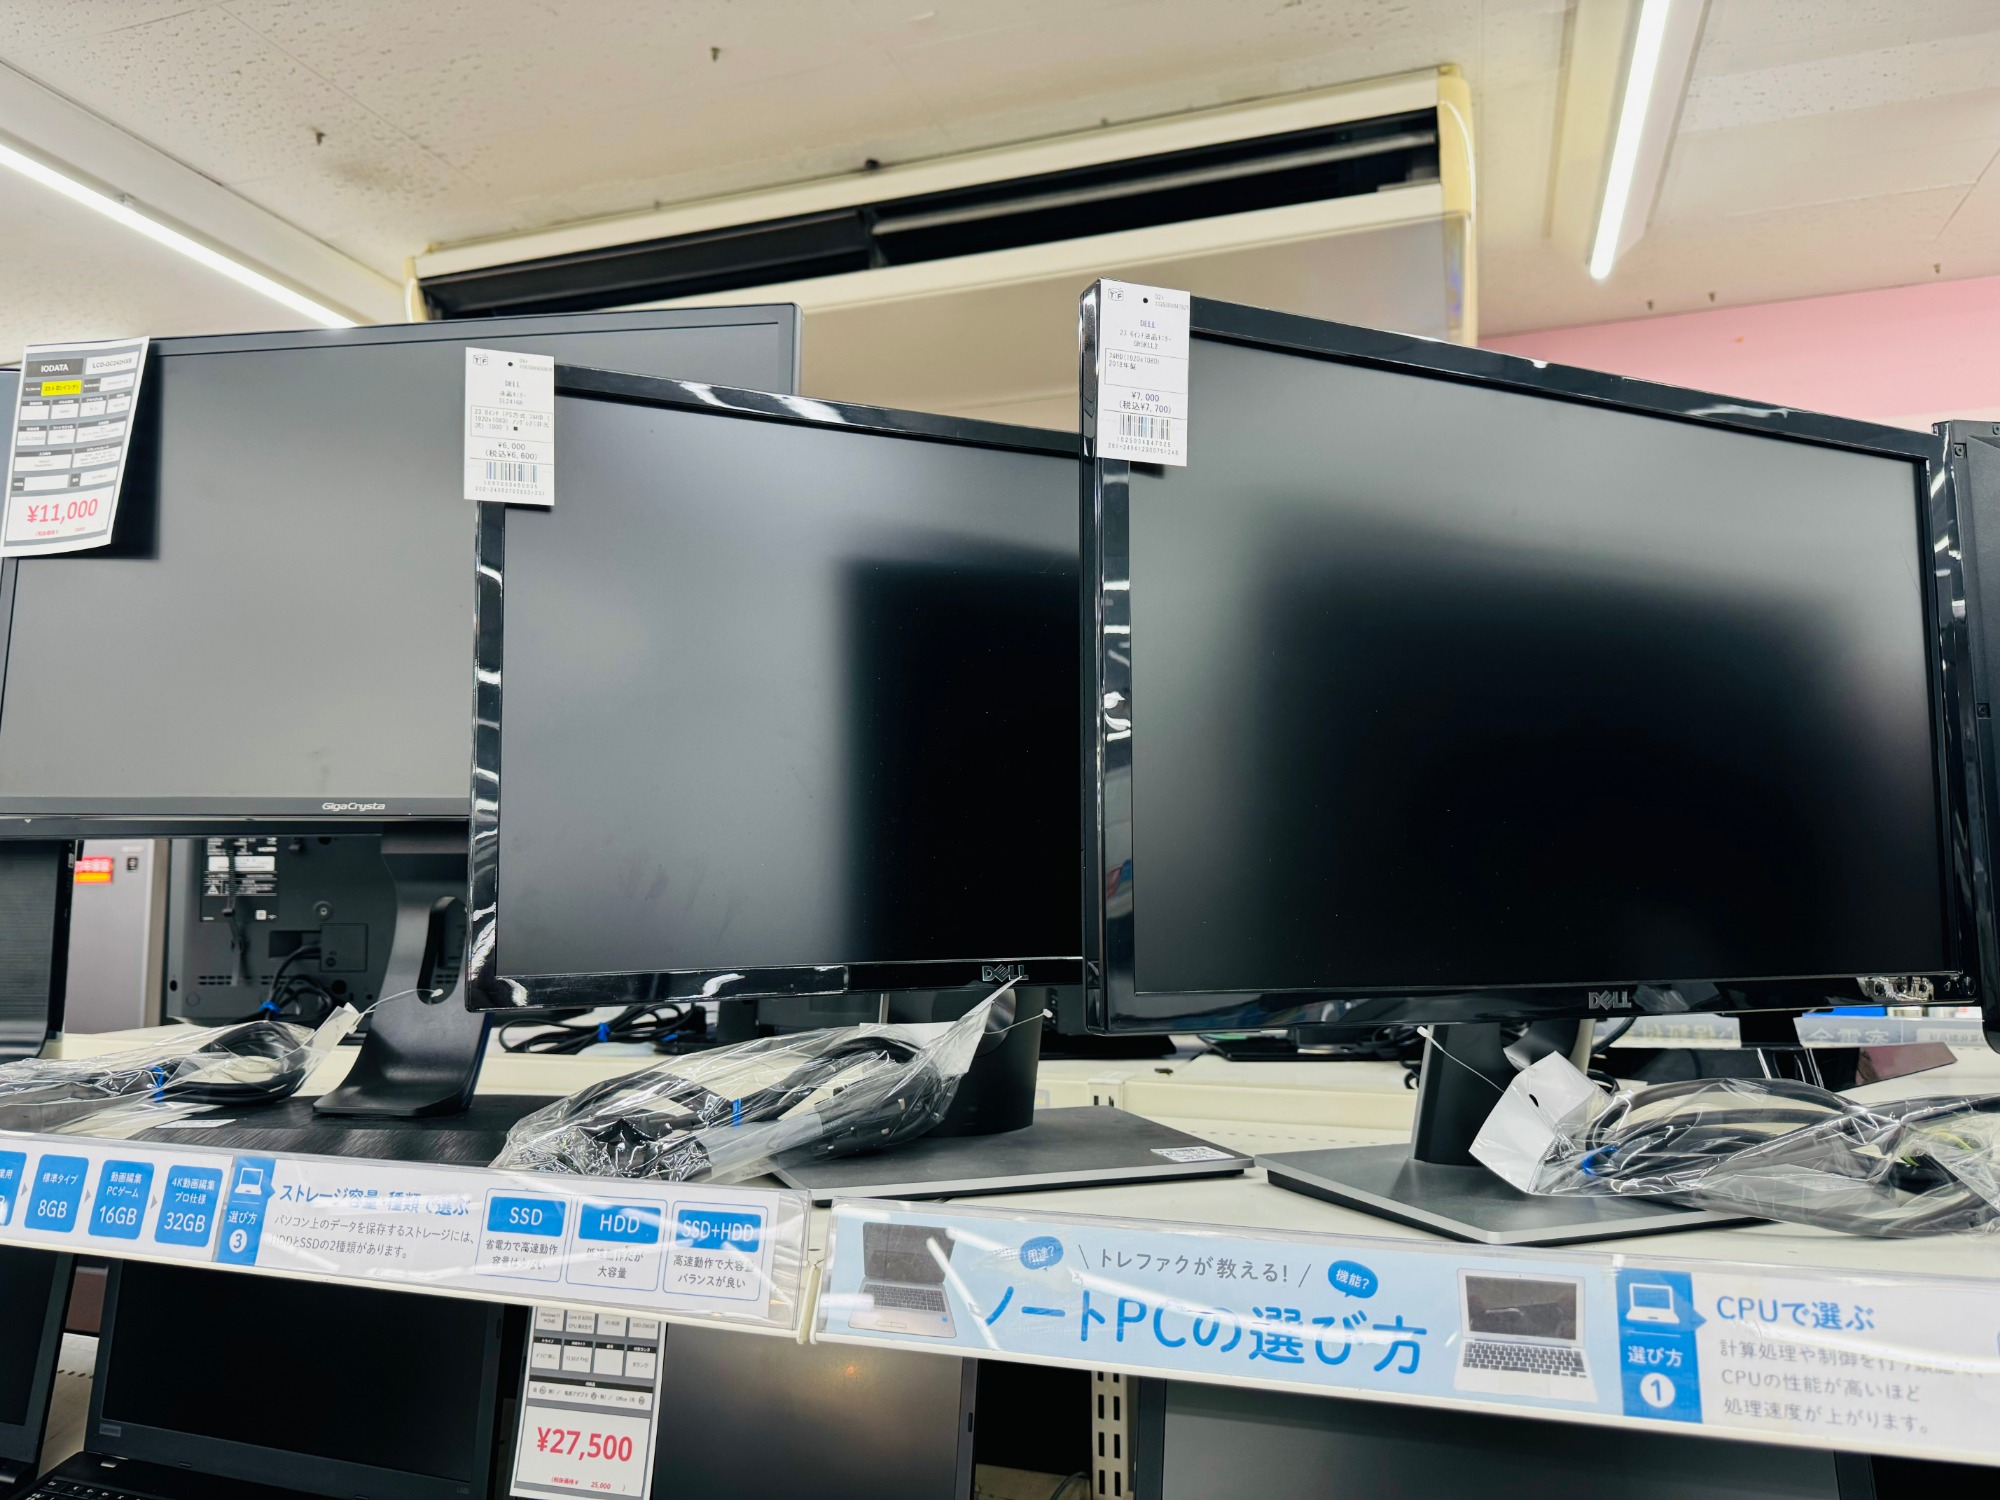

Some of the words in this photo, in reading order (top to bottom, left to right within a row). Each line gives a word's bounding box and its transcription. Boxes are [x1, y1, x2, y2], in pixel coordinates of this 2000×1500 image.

[1140, 320, 1156, 329] DELL
[40, 363, 69, 373] IODATA
[504, 380, 520, 388] DELL
[1131, 391, 1160, 402] ¥7,000
[1119, 401, 1172, 415] (税込¥7,700)
[485, 451, 538, 460] (税込¥6,600)
[497, 442, 526, 450] ¥6,000
[27, 498, 98, 523] ¥11,000
[321, 802, 386, 812] GigaCrysta
[981, 963, 1029, 983] DELL
[1588, 990, 1632, 1011] DELL
[42, 1172, 78, 1185] 標準タイプ
[110, 1171, 142, 1184] 動画編集
[171, 1178, 216, 1191] 4K動画編集
[106, 1185, 139, 1198] PCゲーム
[175, 1192, 206, 1205] プロ仕様
[37, 1199, 67, 1219] 8GB
[99, 1205, 138, 1226] 16GB
[228, 1210, 258, 1225] 選び方
[509, 1206, 543, 1226] SSD
[164, 1212, 206, 1233] 32GB
[274, 1214, 476, 1245] パソコン上のデータを保存するストレージには、
[599, 1214, 640, 1234] HDD
[682, 1219, 754, 1243] SSD+HDD
[270, 1234, 408, 1259] HDDとSSDの2種類があります。
[486, 1239, 558, 1255] 省電力で高速動作
[597, 1266, 627, 1280] 大容量
[672, 1254, 755, 1274] 高速動作で大容量
[1100, 1251, 1289, 1284] トレファクが教える!
[677, 1273, 747, 1289] バランスが良い
[1335, 1268, 1371, 1291] 機能?
[1716, 1295, 1876, 1331] CPUで選ぶ
[984, 1285, 1429, 1376] ノートPCの選び方
[1627, 1345, 1684, 1369] 選び方
[1721, 1368, 1922, 1404] CPUの性能が高いほど
[1724, 1398, 1929, 1435] 処理速度が上がります。
[537, 1426, 634, 1462] ¥27,500
